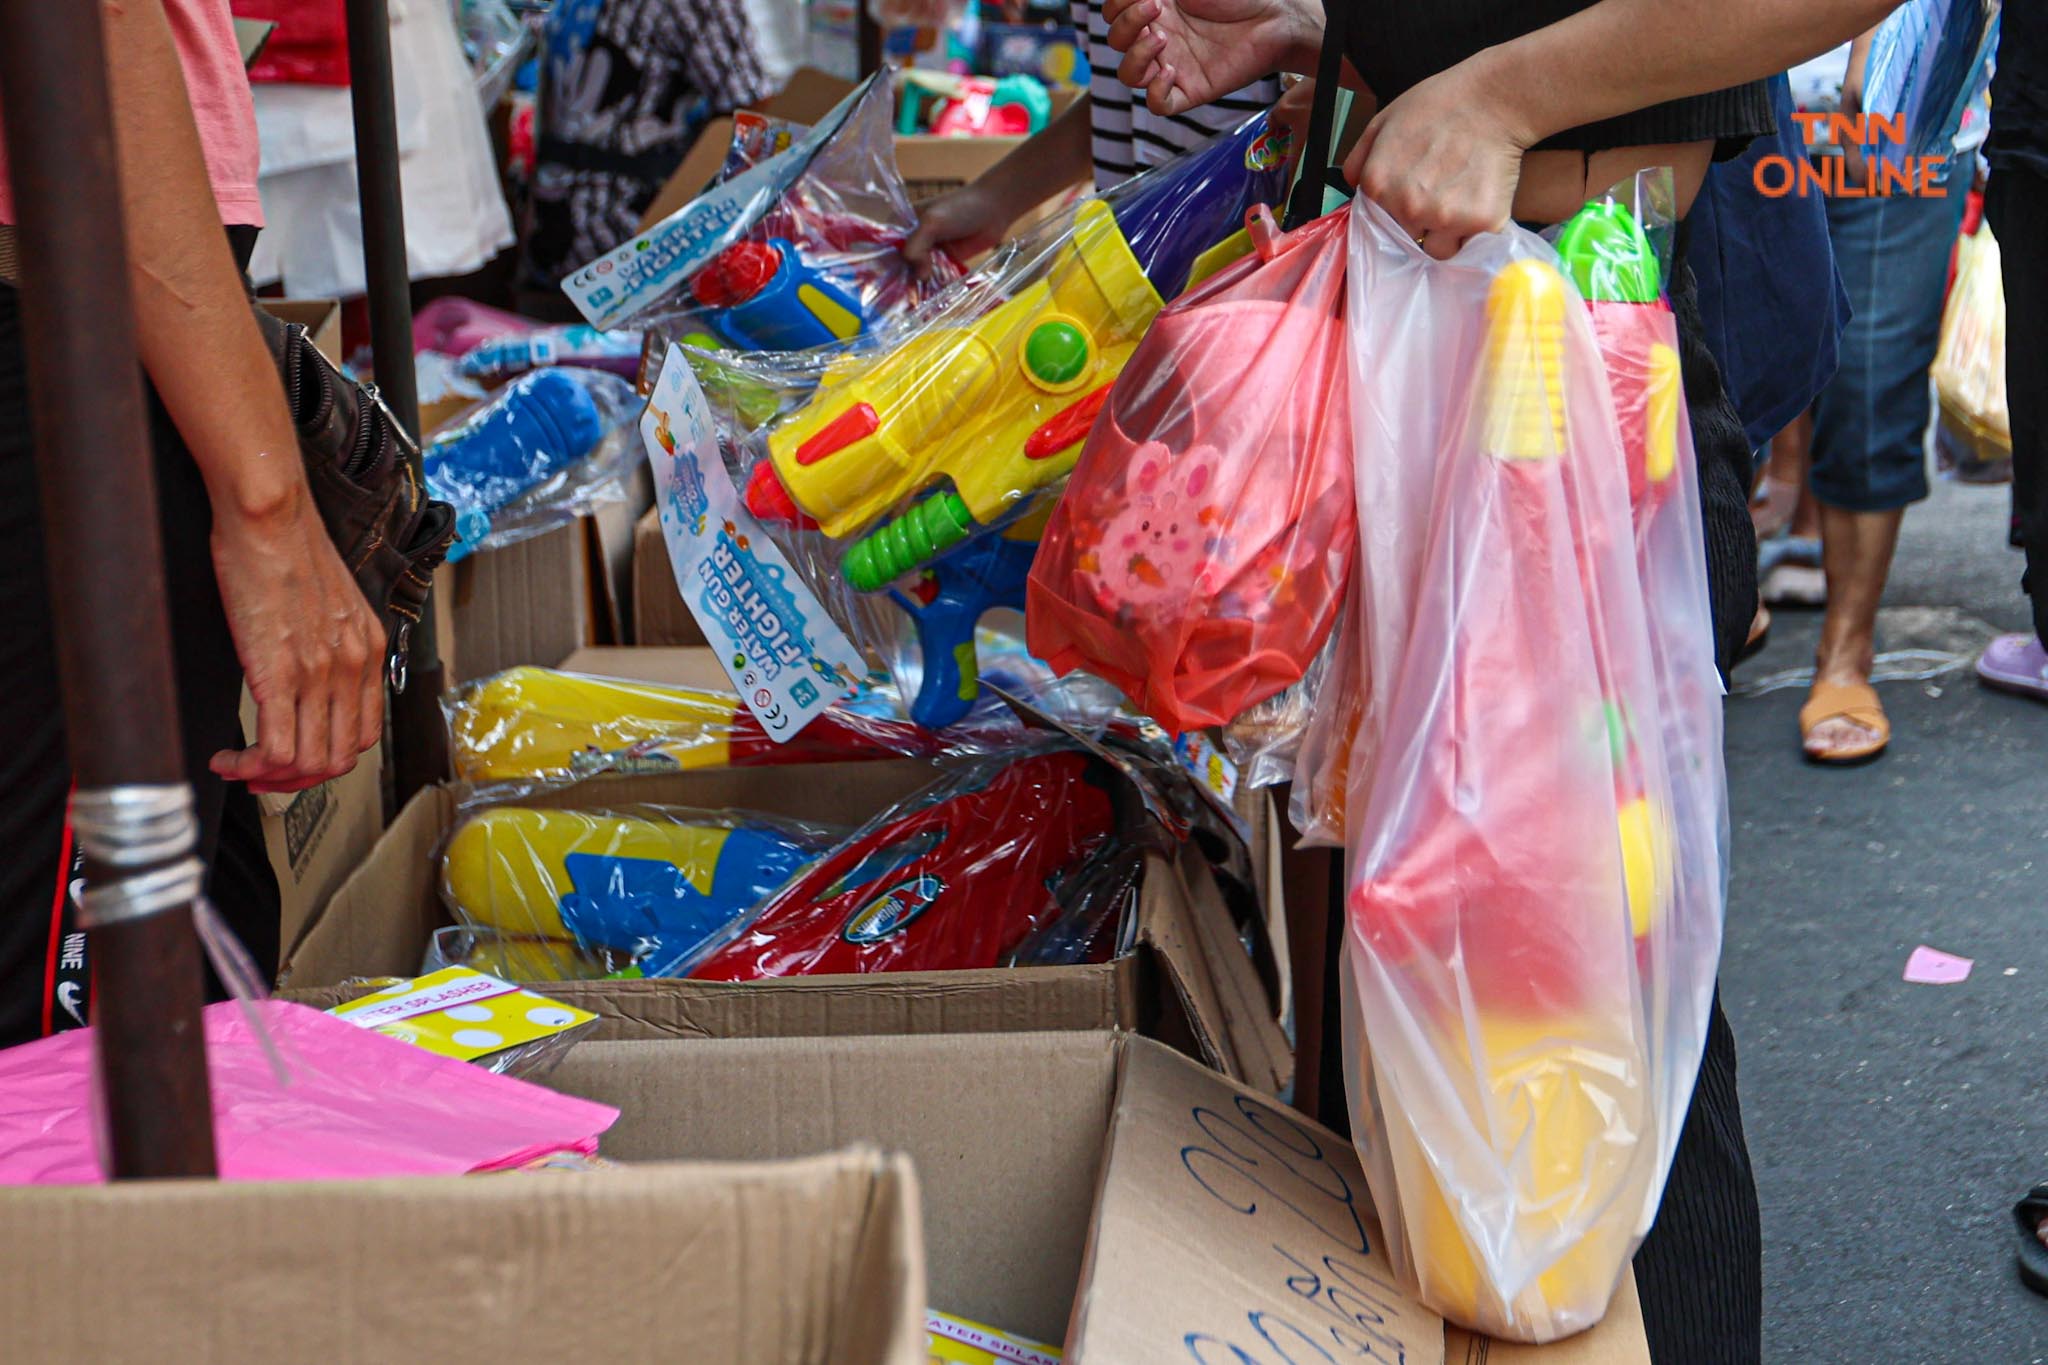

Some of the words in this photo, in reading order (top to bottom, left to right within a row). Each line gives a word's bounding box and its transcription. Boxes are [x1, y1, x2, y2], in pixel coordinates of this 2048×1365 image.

[699, 557, 731, 609] GUN
[713, 542, 802, 667] FIGHTER
[728, 606, 781, 682] WATER
[60, 932, 87, 970] NINE
[405, 982, 496, 1009] SPLASHER
[928, 1319, 983, 1343] ATER
